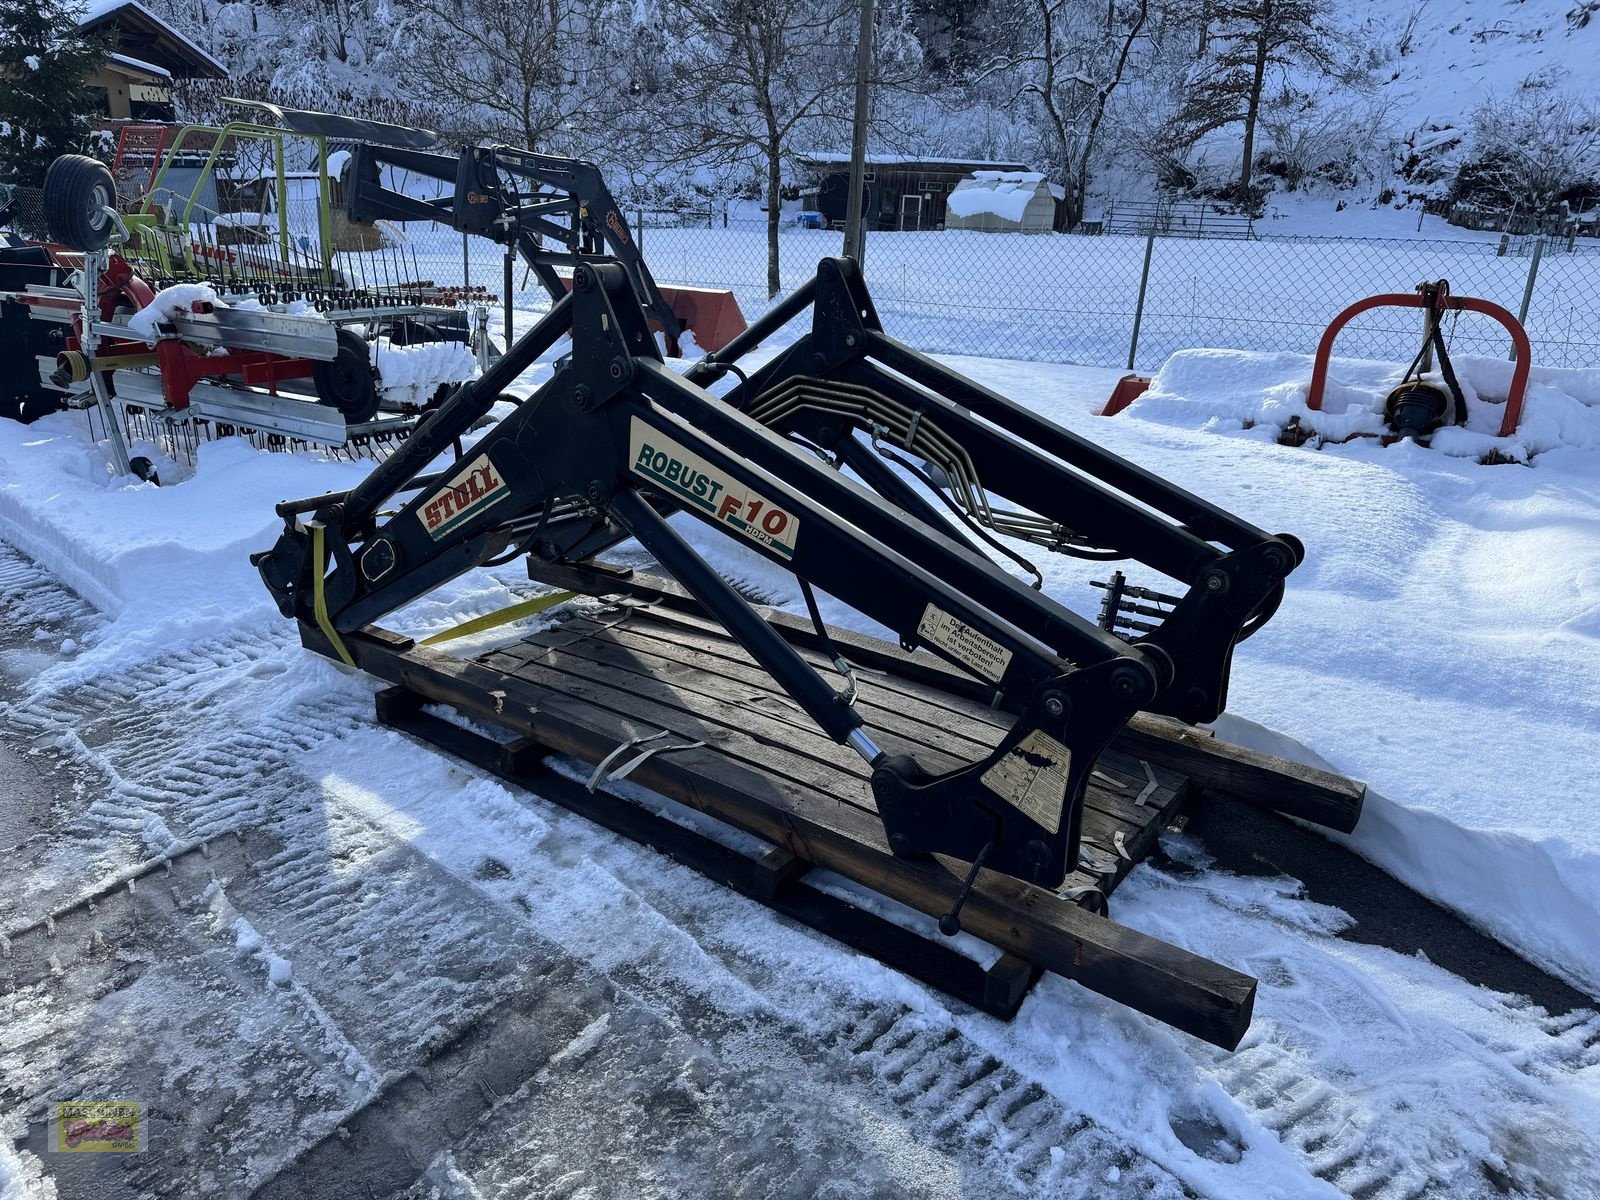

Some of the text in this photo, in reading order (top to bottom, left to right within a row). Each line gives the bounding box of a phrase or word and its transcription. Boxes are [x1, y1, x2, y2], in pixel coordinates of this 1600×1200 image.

[424, 466, 500, 529] STOLL
[637, 443, 788, 535] ROBUST F10
[744, 525, 774, 545] HDPM
[941, 623, 1006, 666] im Arbeitsbereich
[947, 635, 993, 668] ist verboten!
[964, 627, 1004, 655] Aufenthalt
